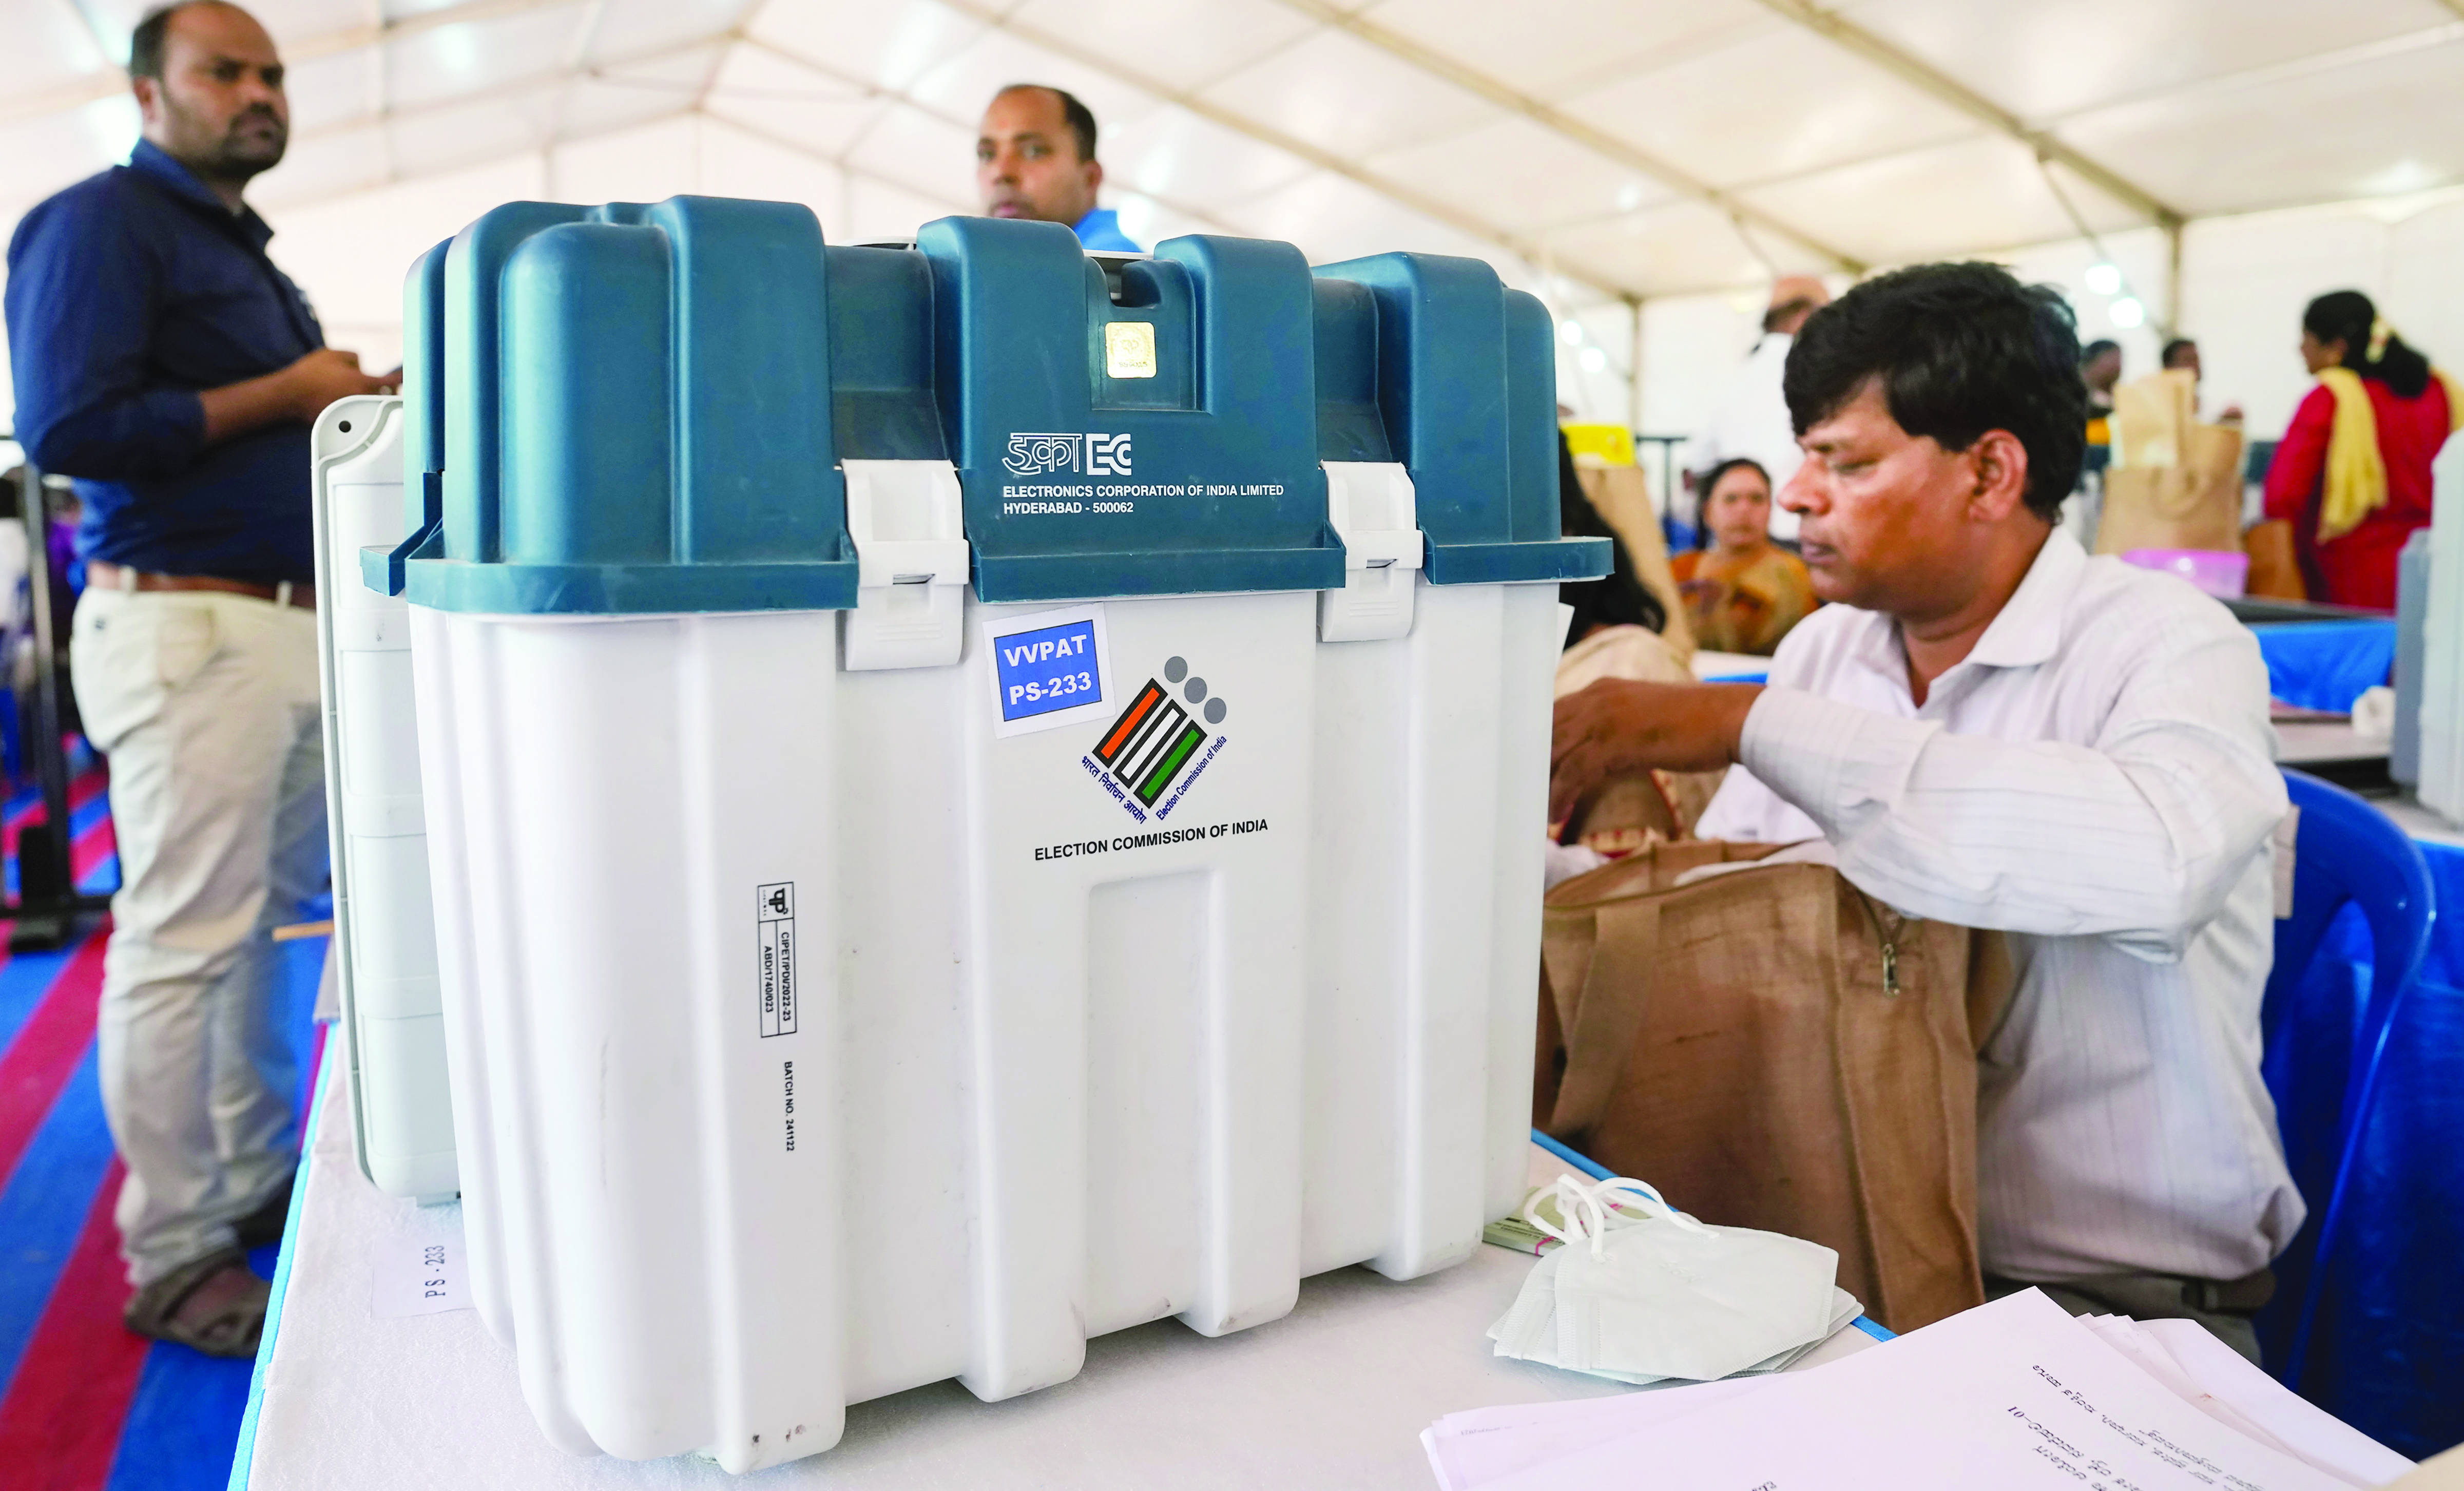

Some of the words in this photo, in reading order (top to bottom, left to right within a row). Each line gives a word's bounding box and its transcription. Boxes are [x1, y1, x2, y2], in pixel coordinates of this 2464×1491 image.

[1004, 486, 1093, 497] ELECTRONICS
[1096, 485, 1184, 496] CORPORATION
[1188, 485, 1203, 496] OF
[1207, 485, 1237, 495] INDIA
[1241, 485, 1283, 495] LIMITED
[1004, 502, 1082, 514] HYDERABAD
[1093, 502, 1133, 513] 500062
[1004, 635, 1086, 666] VVPAT
[1010, 672, 1091, 705] PS-233
[1207, 746, 1218, 759] of
[1211, 736, 1226, 753] India
[1082, 756, 1100, 777] भारत
[1099, 773, 1125, 802] निर्वाचन
[1124, 800, 1147, 824] आयोग
[1177, 757, 1211, 795] Commission
[1156, 788, 1183, 820] Election
[1035, 840, 1107, 861] ELECTION
[1113, 827, 1205, 850] COMMISSION
[1210, 824, 1228, 837] OF
[1233, 819, 1267, 834] INDIA
[765, 946, 773, 1012] ABD/1740/023
[782, 932, 791, 1021] CIPET/PDI/2022-23
[425, 1246, 445, 1265] 233
[425, 1279, 445, 1297] PS
